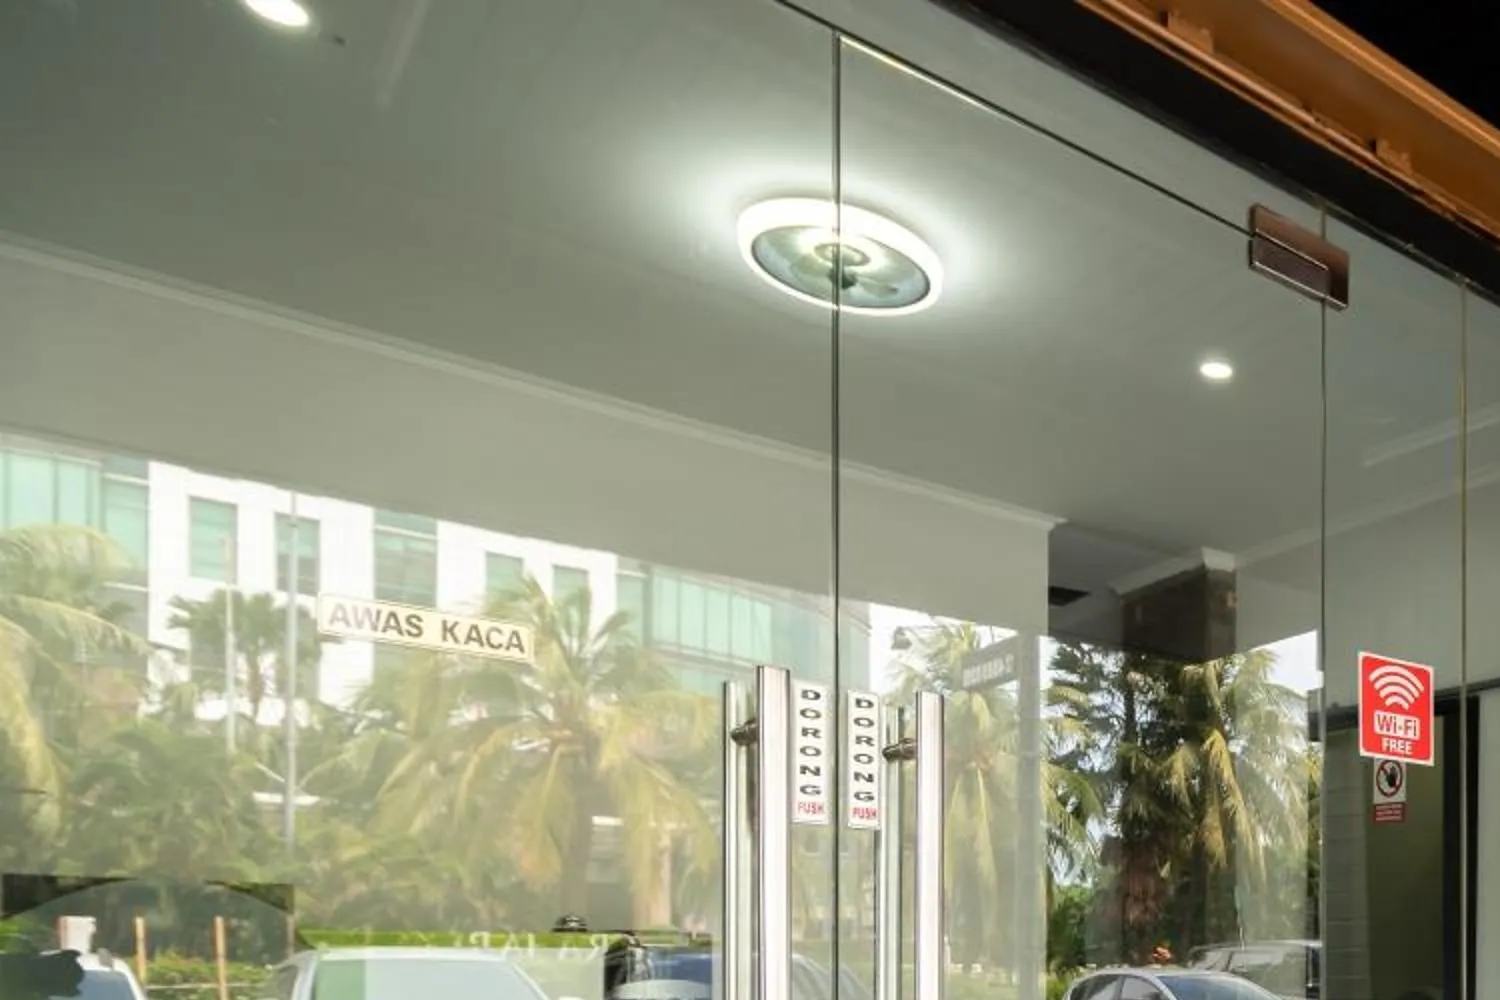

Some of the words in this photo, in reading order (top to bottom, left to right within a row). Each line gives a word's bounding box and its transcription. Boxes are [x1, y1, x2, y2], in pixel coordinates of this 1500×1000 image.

[329, 602, 424, 638] AWAS
[441, 618, 525, 653] KACA
[1376, 713, 1417, 737] Wi-Fi
[799, 689, 822, 796] DORONG
[853, 698, 875, 802] DORONG
[1382, 736, 1413, 754] FREE
[798, 801, 825, 815] PUSH
[853, 806, 877, 820] PUSH
